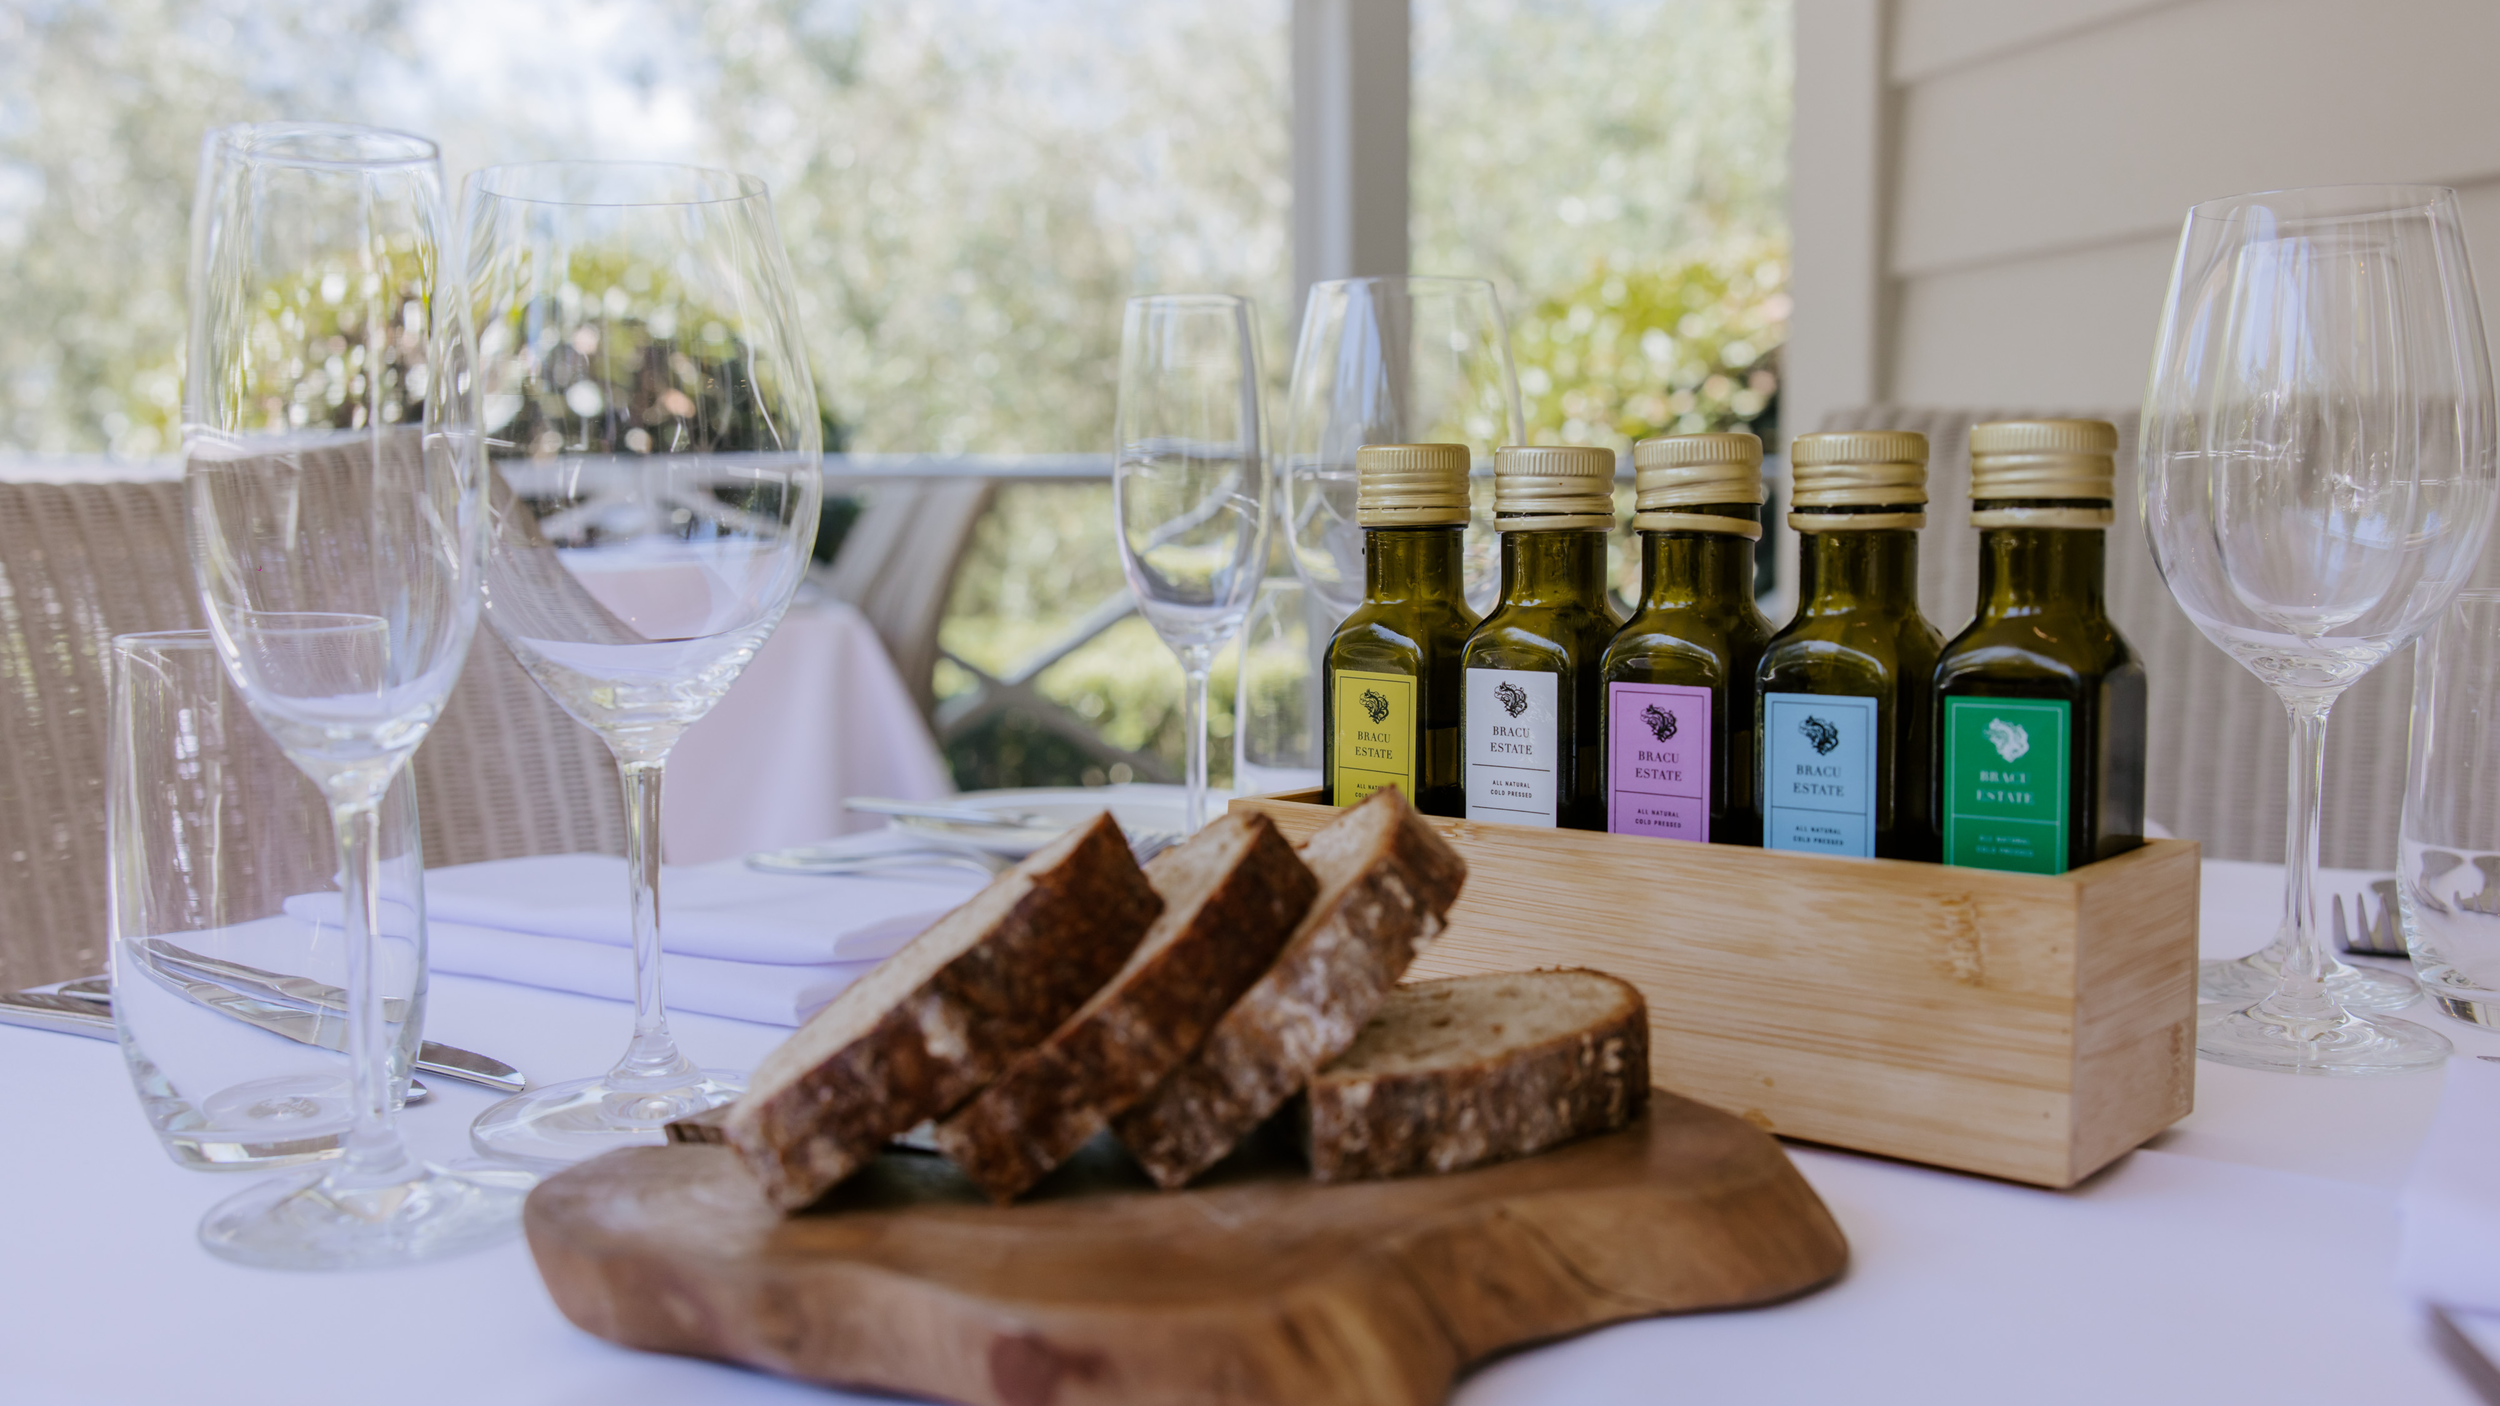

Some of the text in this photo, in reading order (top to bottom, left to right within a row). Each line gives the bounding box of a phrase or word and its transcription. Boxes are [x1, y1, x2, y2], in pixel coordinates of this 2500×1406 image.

[1357, 730, 1391, 744] BRACU
[1492, 725, 1530, 738] BRACU
[1355, 746, 1393, 760] ESTATE
[1490, 742, 1533, 755] ESTATE
[1638, 750, 1680, 764] BRACU
[1635, 767, 1682, 781] ESTATE
[1796, 764, 1841, 778] BRACU
[1979, 770, 2031, 785] BRACU
[1505, 781, 1531, 789] NATURAL
[1793, 782, 1844, 797] ESTATE
[1507, 790, 1532, 798] PRESSED
[1976, 789, 2035, 806] ESTATE
[1651, 810, 1679, 818] NATURAL
[1653, 820, 1682, 828] PRESSED
